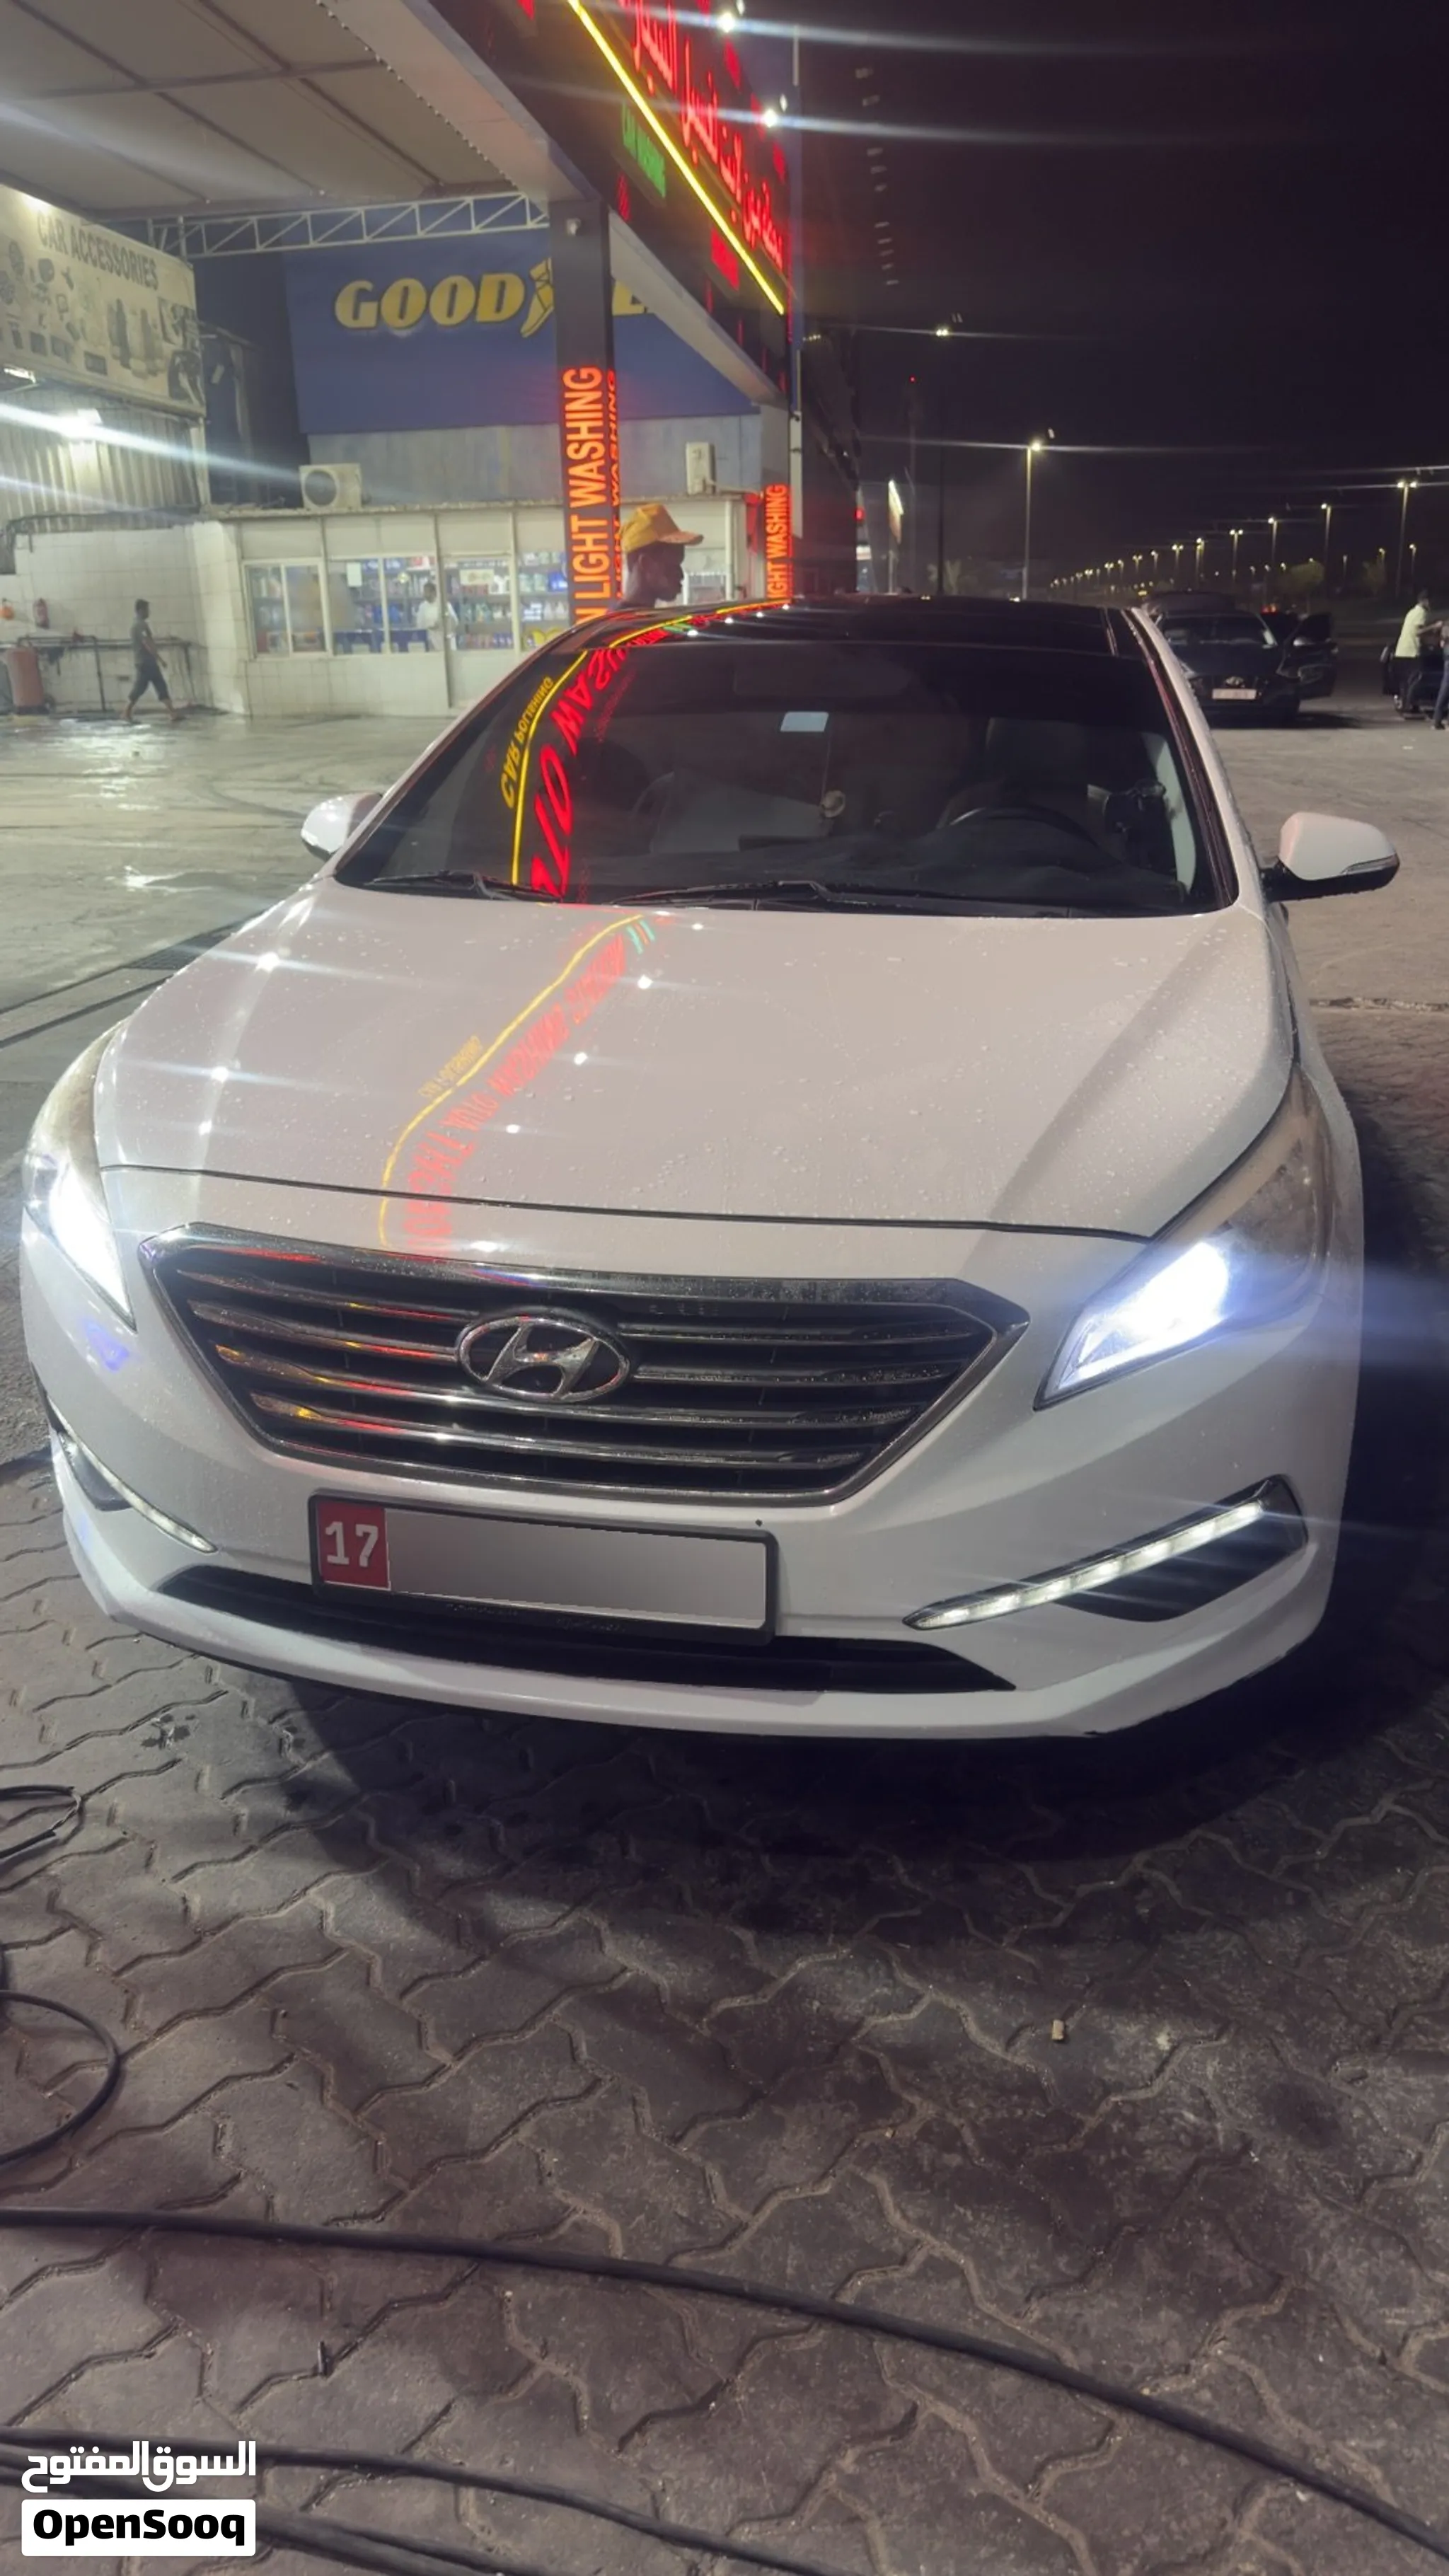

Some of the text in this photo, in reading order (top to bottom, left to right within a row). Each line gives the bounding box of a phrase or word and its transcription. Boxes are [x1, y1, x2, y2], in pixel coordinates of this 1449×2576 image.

[37, 210, 158, 291] CAR ACCESSORIES
[563, 366, 606, 508] WASHING
[570, 514, 611, 599] LIGHT
[765, 484, 788, 599] IGHT WASHING
[325, 1521, 379, 1568] 17
